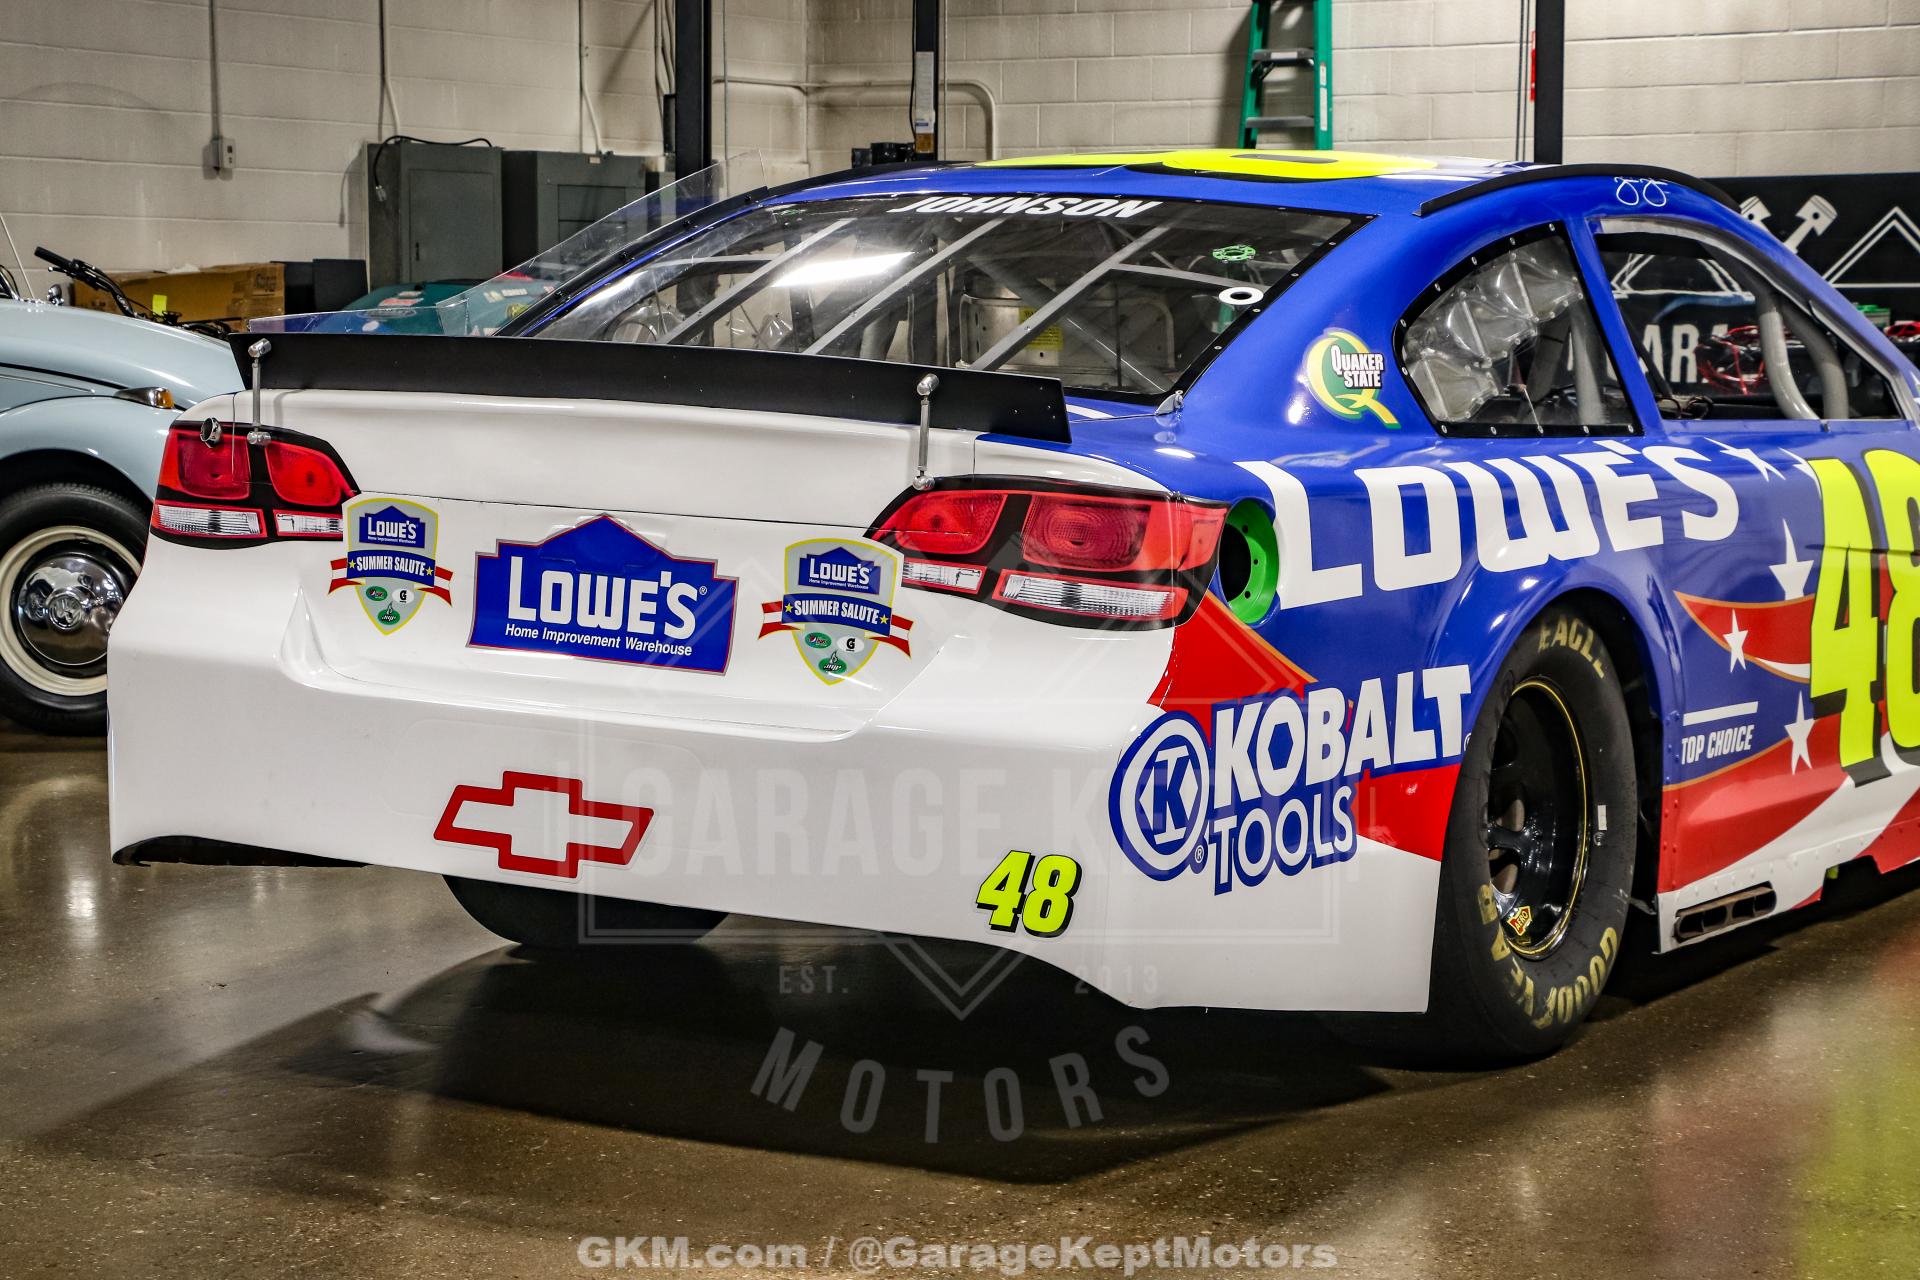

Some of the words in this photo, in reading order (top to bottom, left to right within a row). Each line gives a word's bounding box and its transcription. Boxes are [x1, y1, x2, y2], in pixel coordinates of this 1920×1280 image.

[886, 197, 1163, 218] JOHNSON
[1330, 345, 1384, 376] QUAKER
[1343, 371, 1381, 388] STATE
[367, 516, 417, 540] LOWE'S
[1233, 441, 1740, 610] LOWE'S
[356, 556, 393, 571] SUMMER
[394, 557, 426, 577] SALUTE
[809, 558, 870, 585] LOWE'S
[507, 556, 699, 640] LOWE'S
[794, 599, 840, 617] SUMMER
[841, 601, 880, 625] SALUTE
[505, 623, 539, 639] Home
[542, 627, 621, 649] Improvement
[625, 636, 693, 657] Warehouse
[1538, 614, 1605, 679] EAGLE
[1213, 664, 1472, 809] KOBALT
[1681, 733, 1705, 765] TOP
[1706, 725, 1755, 759] CHOICE
[1208, 785, 1352, 885] TOOLS
[975, 849, 1083, 938] 48
